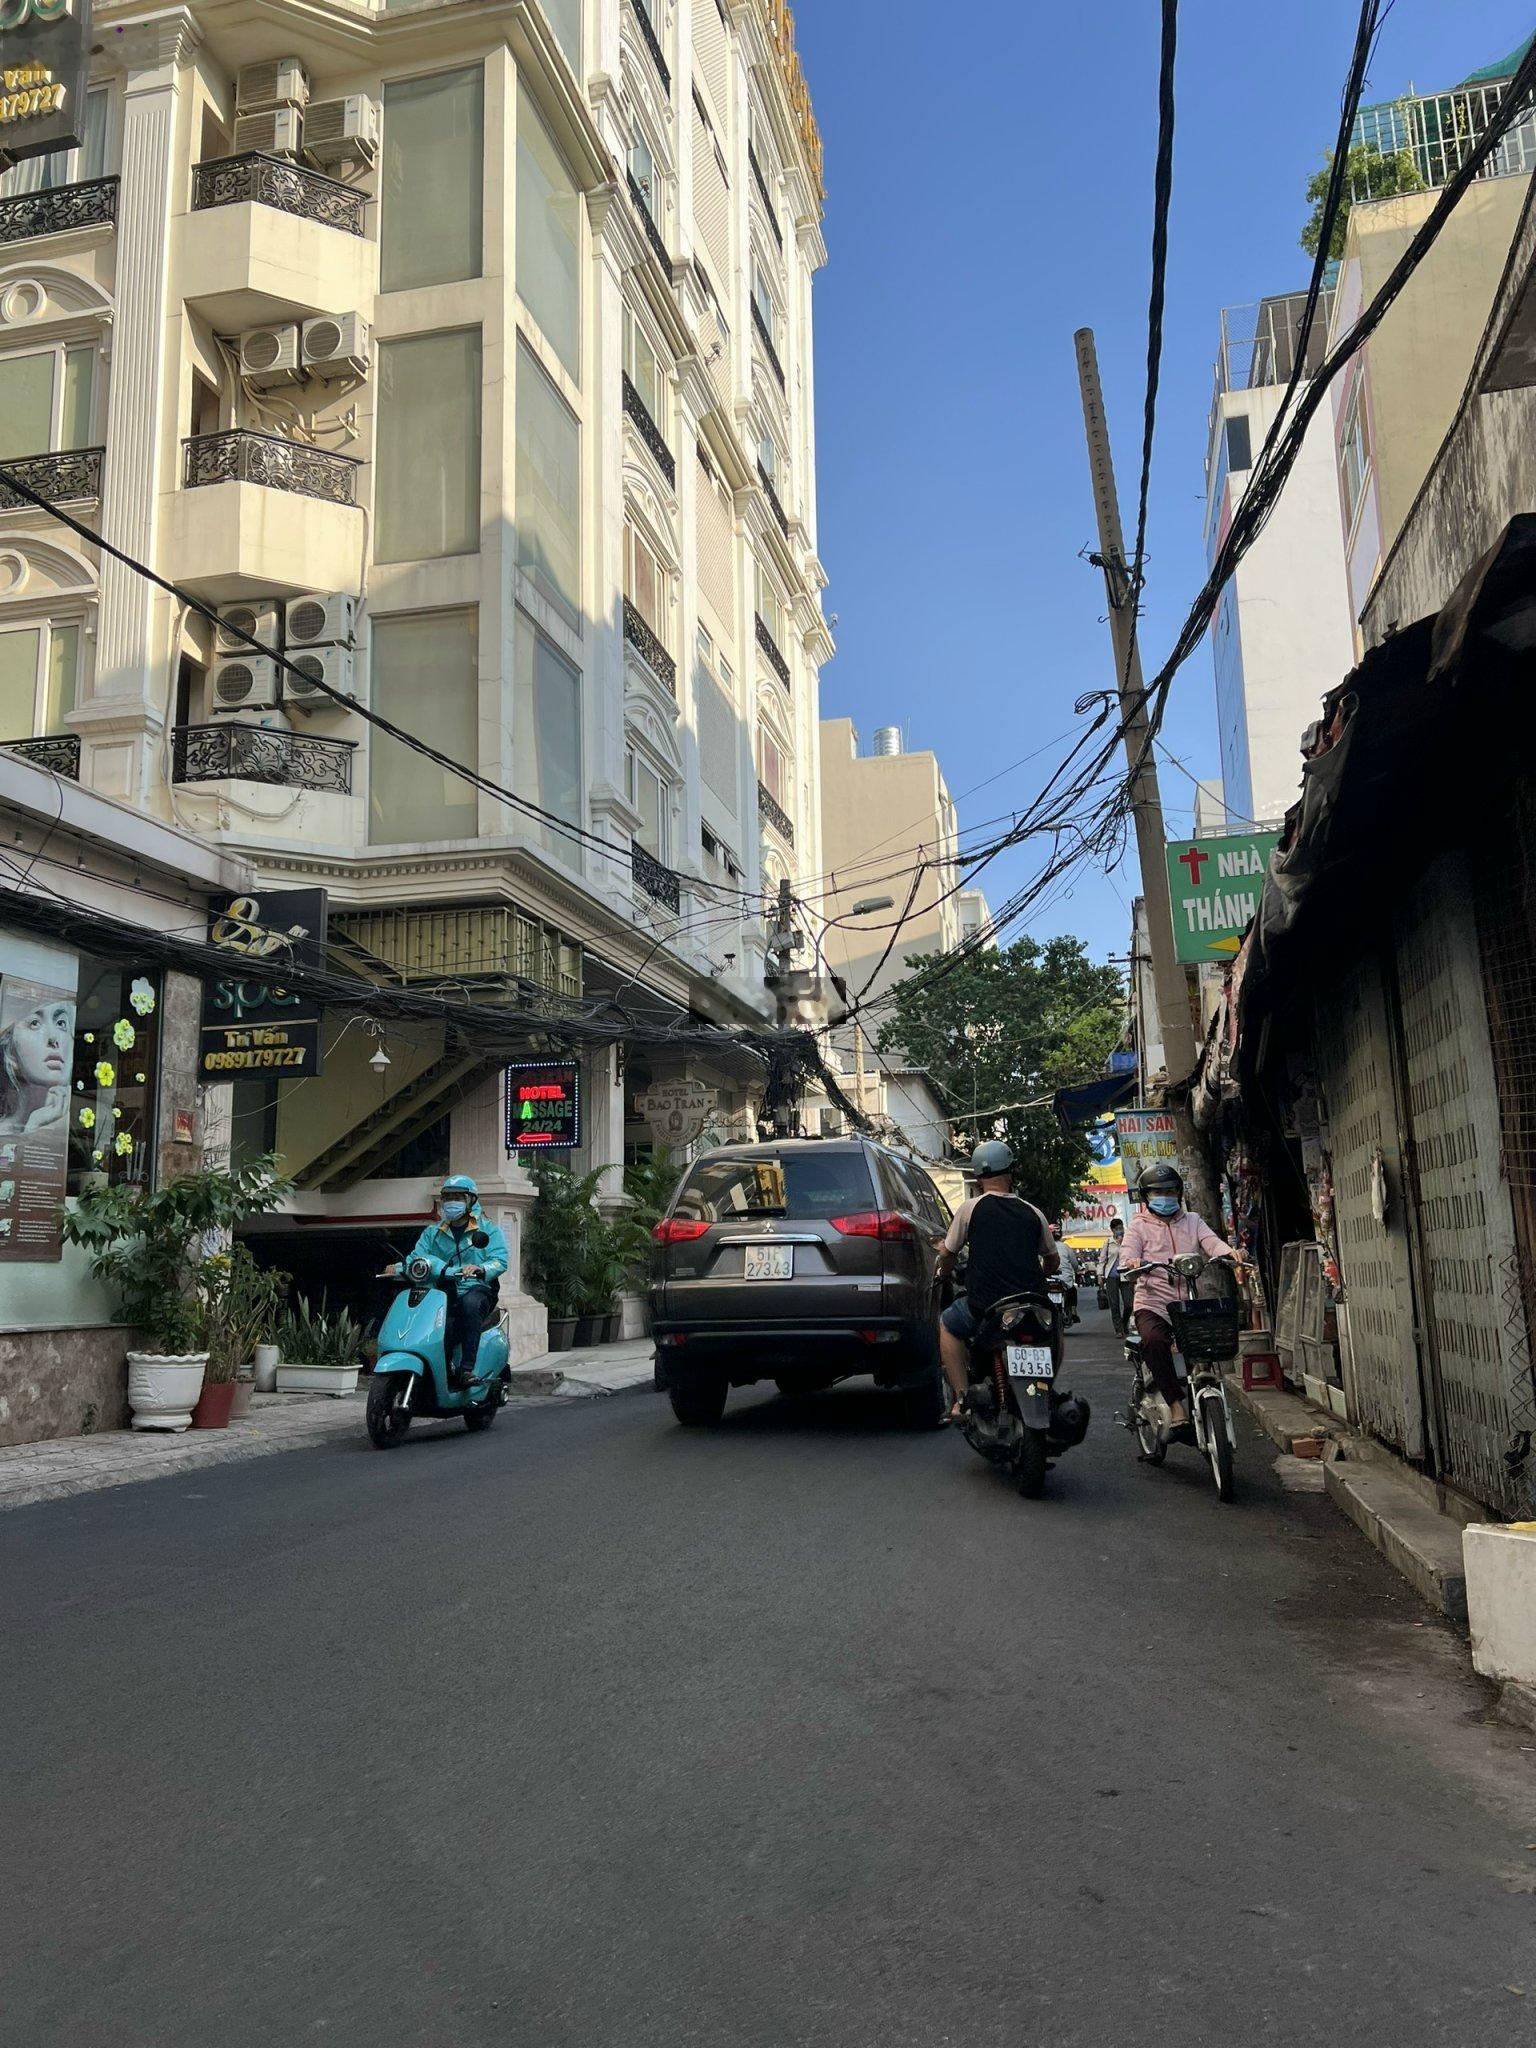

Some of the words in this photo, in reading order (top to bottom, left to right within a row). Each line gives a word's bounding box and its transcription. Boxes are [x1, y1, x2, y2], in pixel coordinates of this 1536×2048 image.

[1217, 844, 1265, 878] NHÀ
[1182, 888, 1256, 932] THÁNH
[252, 1026, 289, 1046] Vấn
[204, 1047, 306, 1070] 0989179727
[519, 1085, 567, 1100] HOTEL
[661, 1088, 689, 1097] HOTEL
[512, 1100, 573, 1119] MASSAGE
[647, 1099, 672, 1111] BAO
[673, 1097, 705, 1110] TRAN
[522, 1120, 563, 1132] 24/24
[747, 1262, 790, 1276] 273.43
[1011, 1361, 1051, 1375] 343.56
